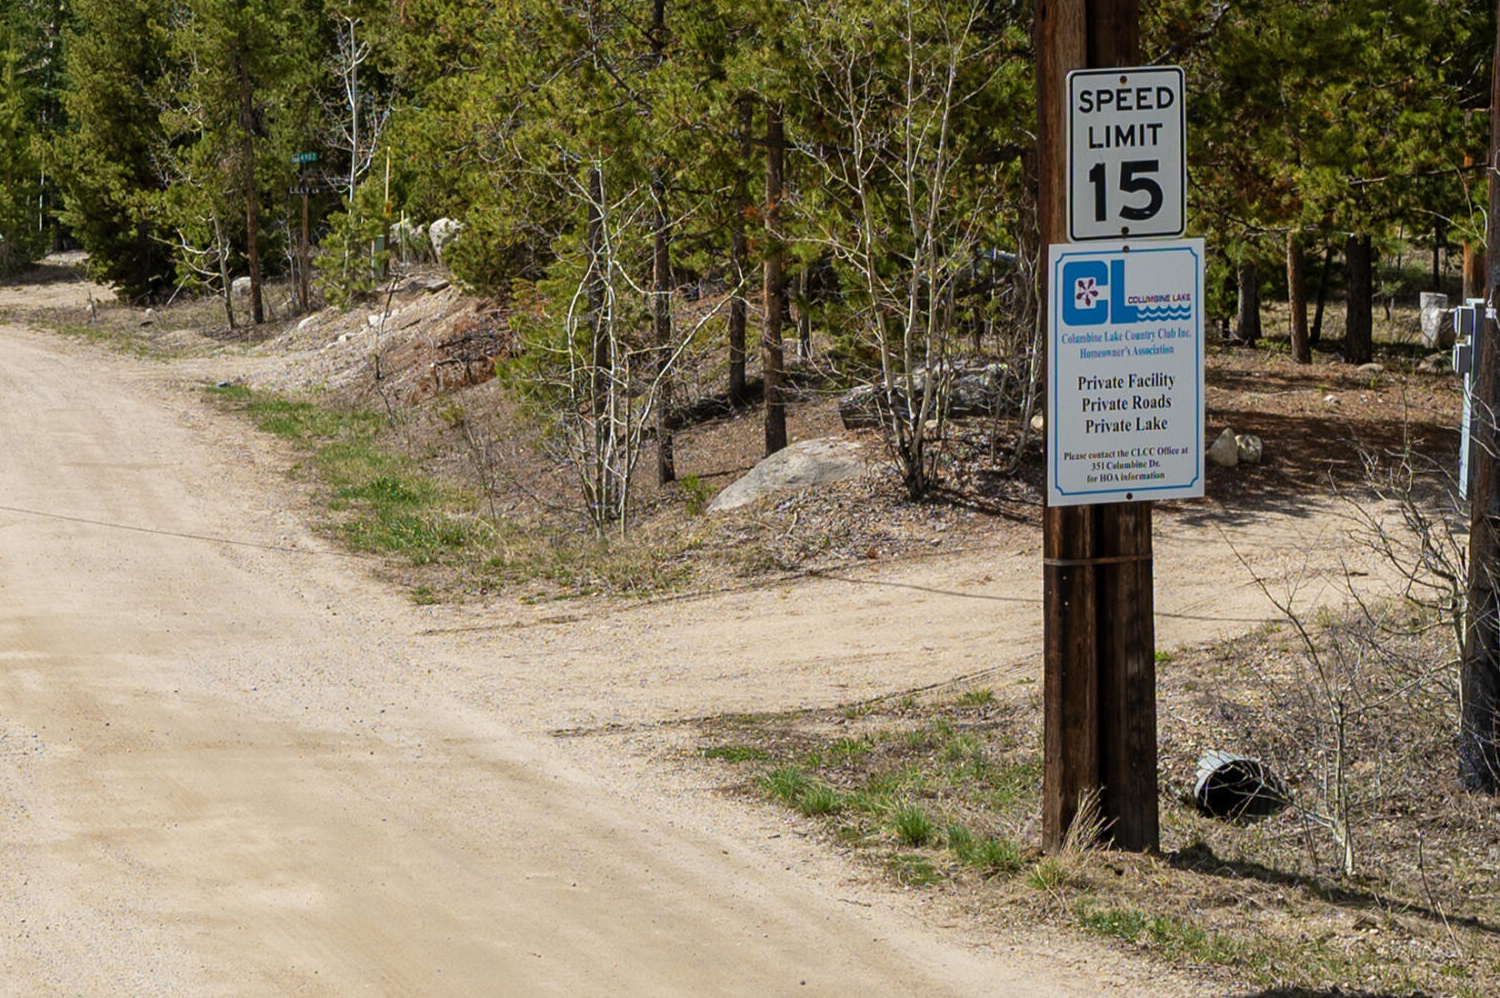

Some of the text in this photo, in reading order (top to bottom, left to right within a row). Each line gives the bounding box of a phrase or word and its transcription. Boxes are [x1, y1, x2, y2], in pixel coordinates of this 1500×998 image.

[1078, 87, 1174, 113] SPEED
[1089, 123, 1163, 149] LIMIT
[1089, 159, 1164, 222] 15
[1128, 293, 1191, 304] COLUMBINE LAKE
[1061, 327, 1191, 344] Columbine Lake Country Club Inc.
[1080, 344, 1174, 359] Homeowner's Association
[1077, 372, 1176, 390] Private Facility
[1082, 394, 1172, 412] Private Roads
[1085, 416, 1168, 434] Private Lake
[1064, 446, 1188, 461] Please contact the CLCC Office at
[1106, 460, 1147, 470] Columbine
[1149, 459, 1161, 468] Dr.
[1087, 471, 1165, 483] for HOA information
